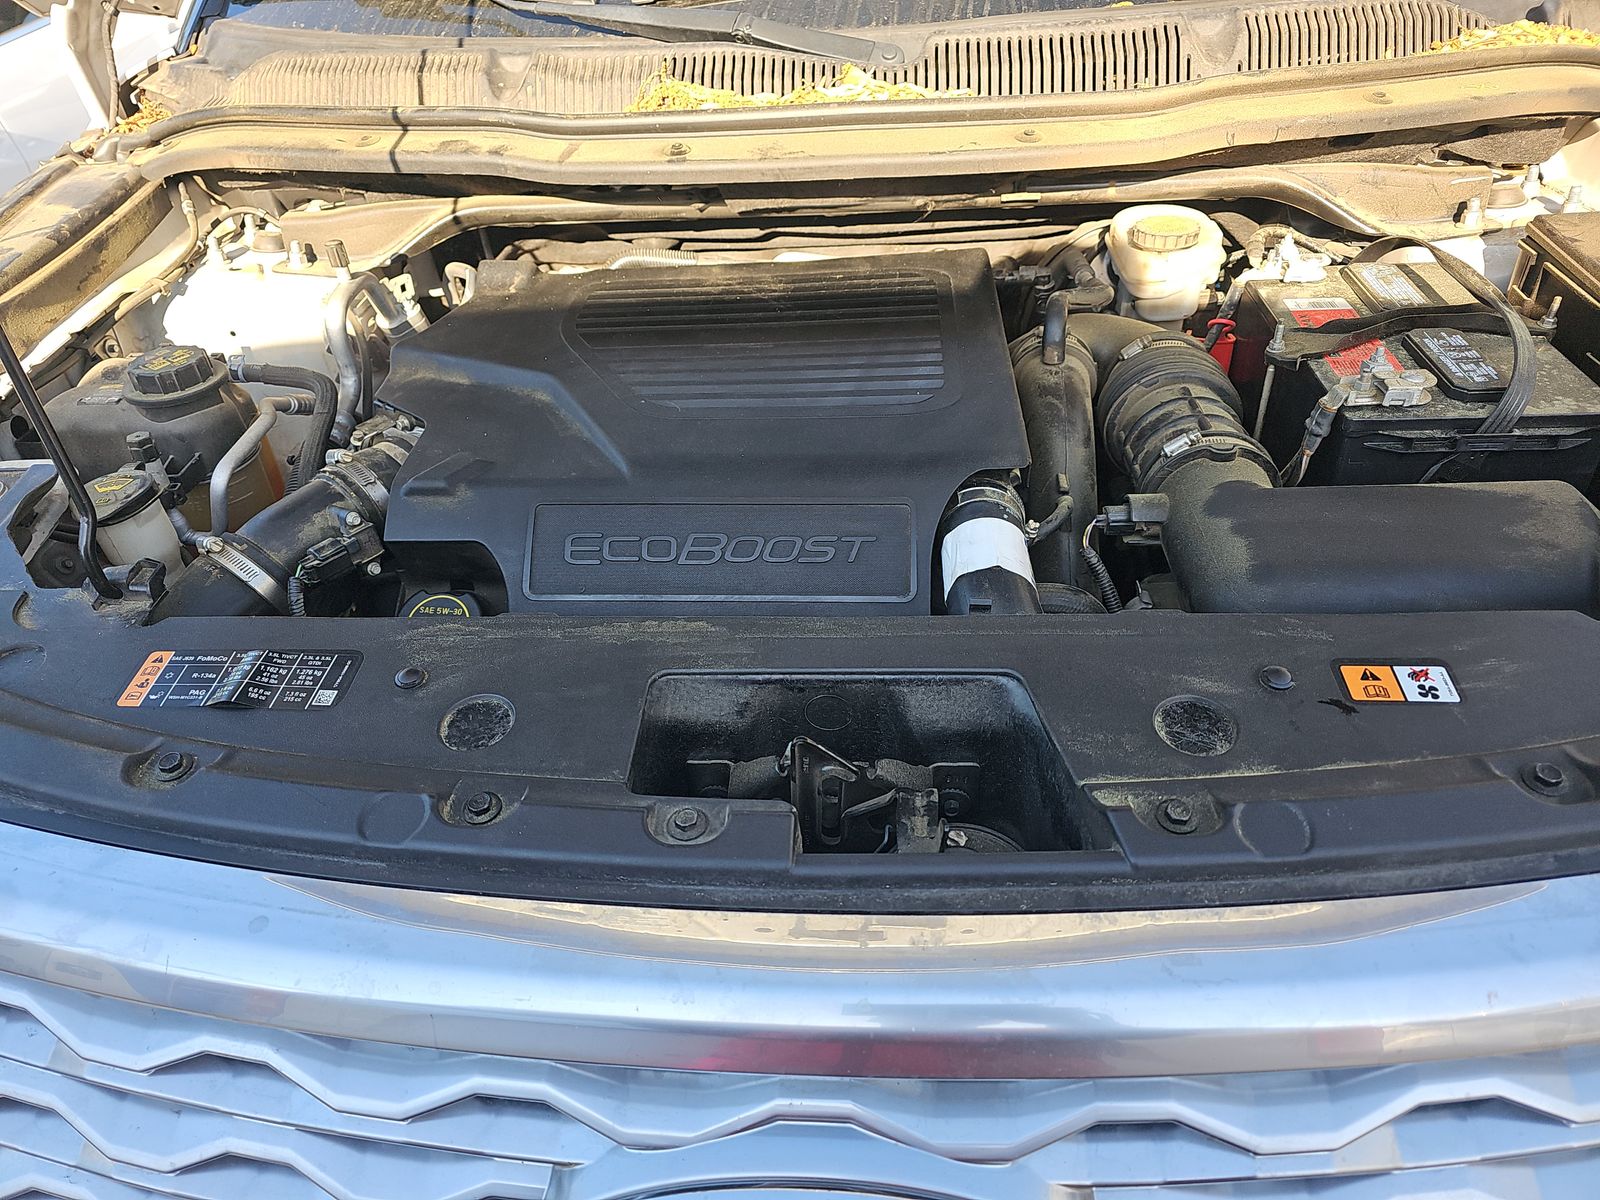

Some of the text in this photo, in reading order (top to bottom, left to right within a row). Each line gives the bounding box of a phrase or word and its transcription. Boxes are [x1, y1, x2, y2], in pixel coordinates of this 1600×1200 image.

[419, 606, 463, 616] SAE 5W-30
[260, 665, 288, 675] 1.162 kg
